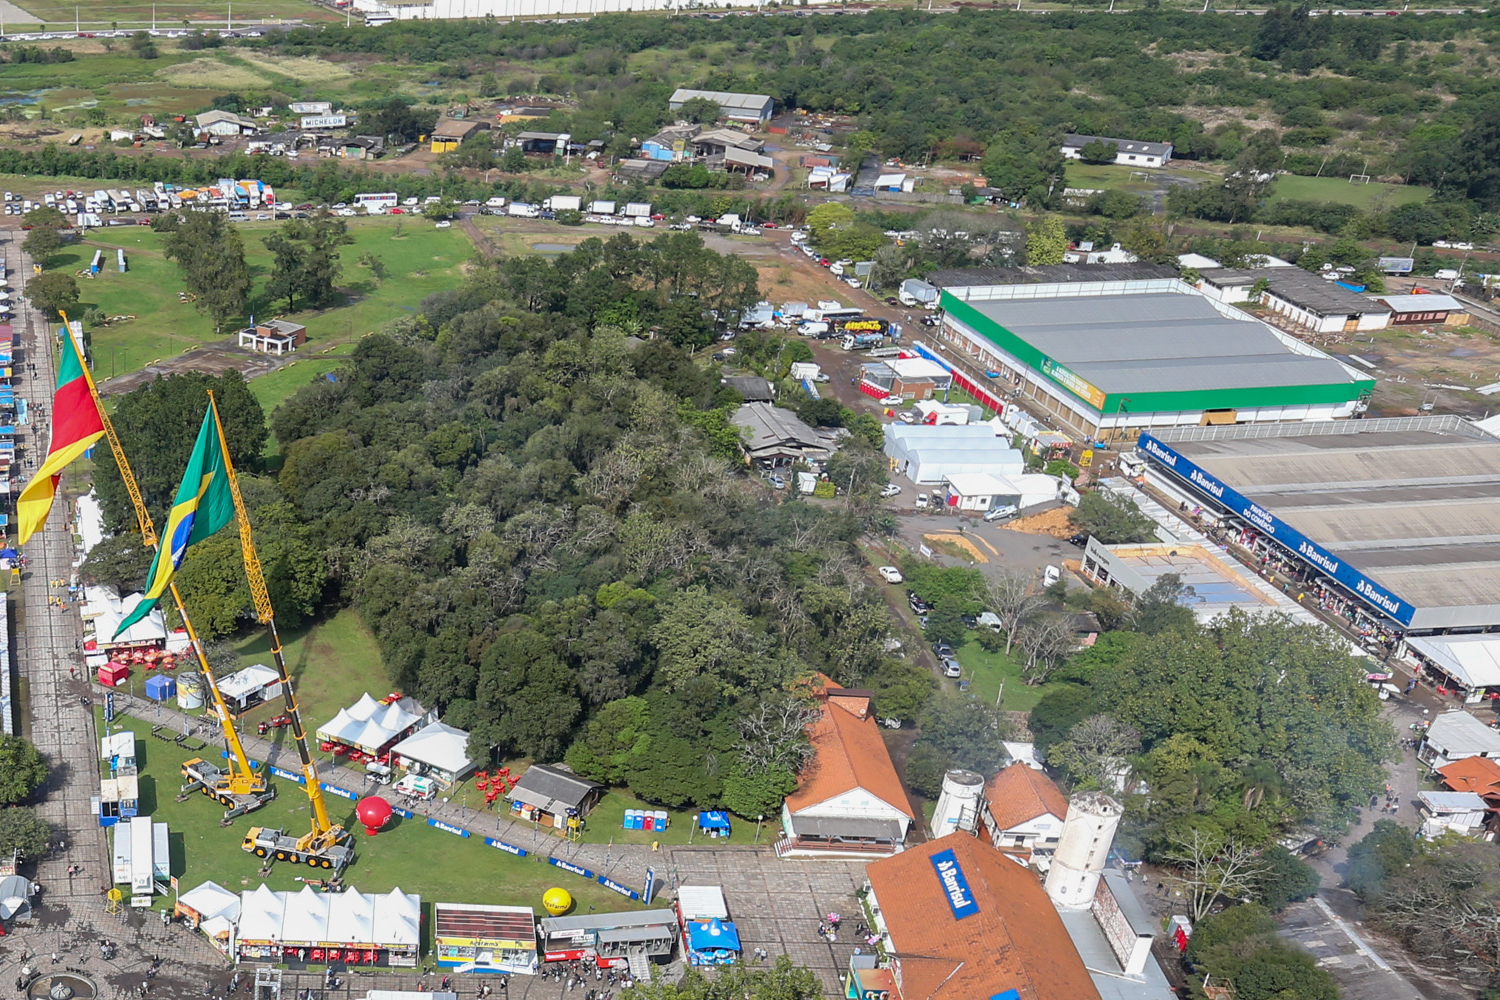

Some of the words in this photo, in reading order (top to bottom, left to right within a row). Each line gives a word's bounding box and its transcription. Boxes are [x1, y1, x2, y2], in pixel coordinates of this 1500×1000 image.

[305, 118, 342, 126] MICHELON
[1152, 442, 1177, 466] Banrisul
[1198, 473, 1224, 497] Banrisul
[1307, 545, 1338, 573] Banrisul
[1364, 584, 1400, 614] Banrisul
[563, 863, 585, 876] Banrisul
[610, 882, 632, 898] Banrisul
[941, 867, 971, 908] Banrisul
